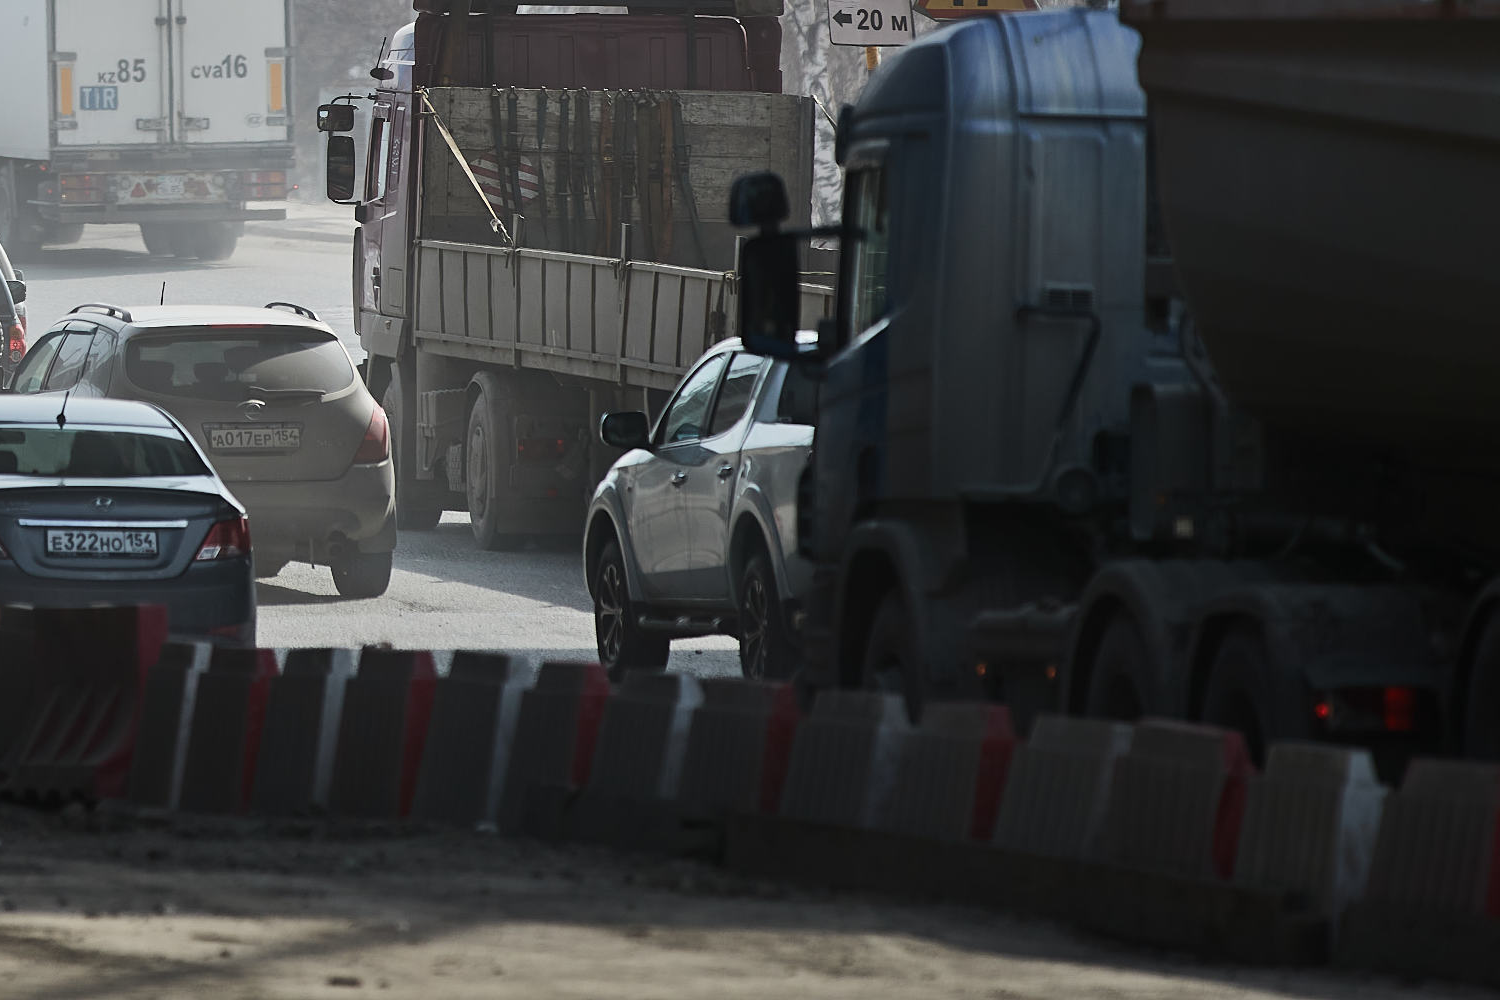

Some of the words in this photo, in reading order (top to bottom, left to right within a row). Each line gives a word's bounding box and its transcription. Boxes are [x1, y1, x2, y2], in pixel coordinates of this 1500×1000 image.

[856, 9, 883, 31] 20
[81, 87, 117, 109] TIR
[52, 533, 123, 551] Е322НО
[126, 533, 152, 548] 154
